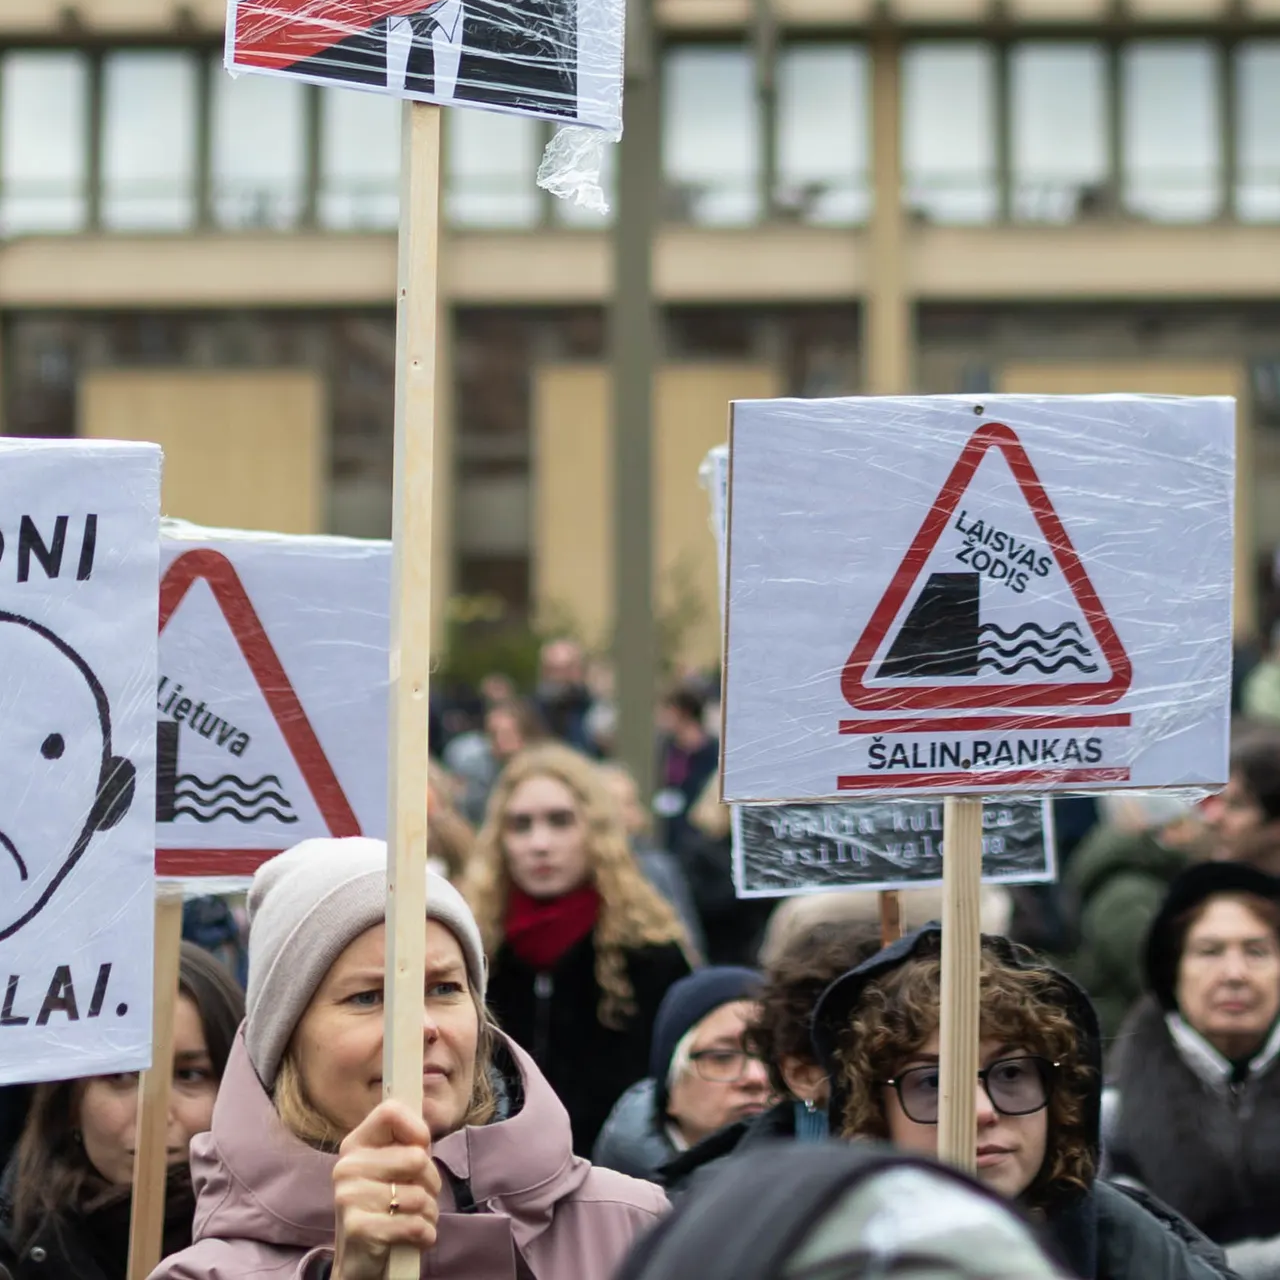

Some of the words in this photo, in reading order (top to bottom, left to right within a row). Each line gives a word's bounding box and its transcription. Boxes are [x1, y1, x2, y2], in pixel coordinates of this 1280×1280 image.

[954, 509, 1053, 578] LAISVAS
[955, 536, 1030, 594] ŽODIS
[867, 736, 962, 770] ŠALIN
[972, 737, 1102, 767] RANKAS
